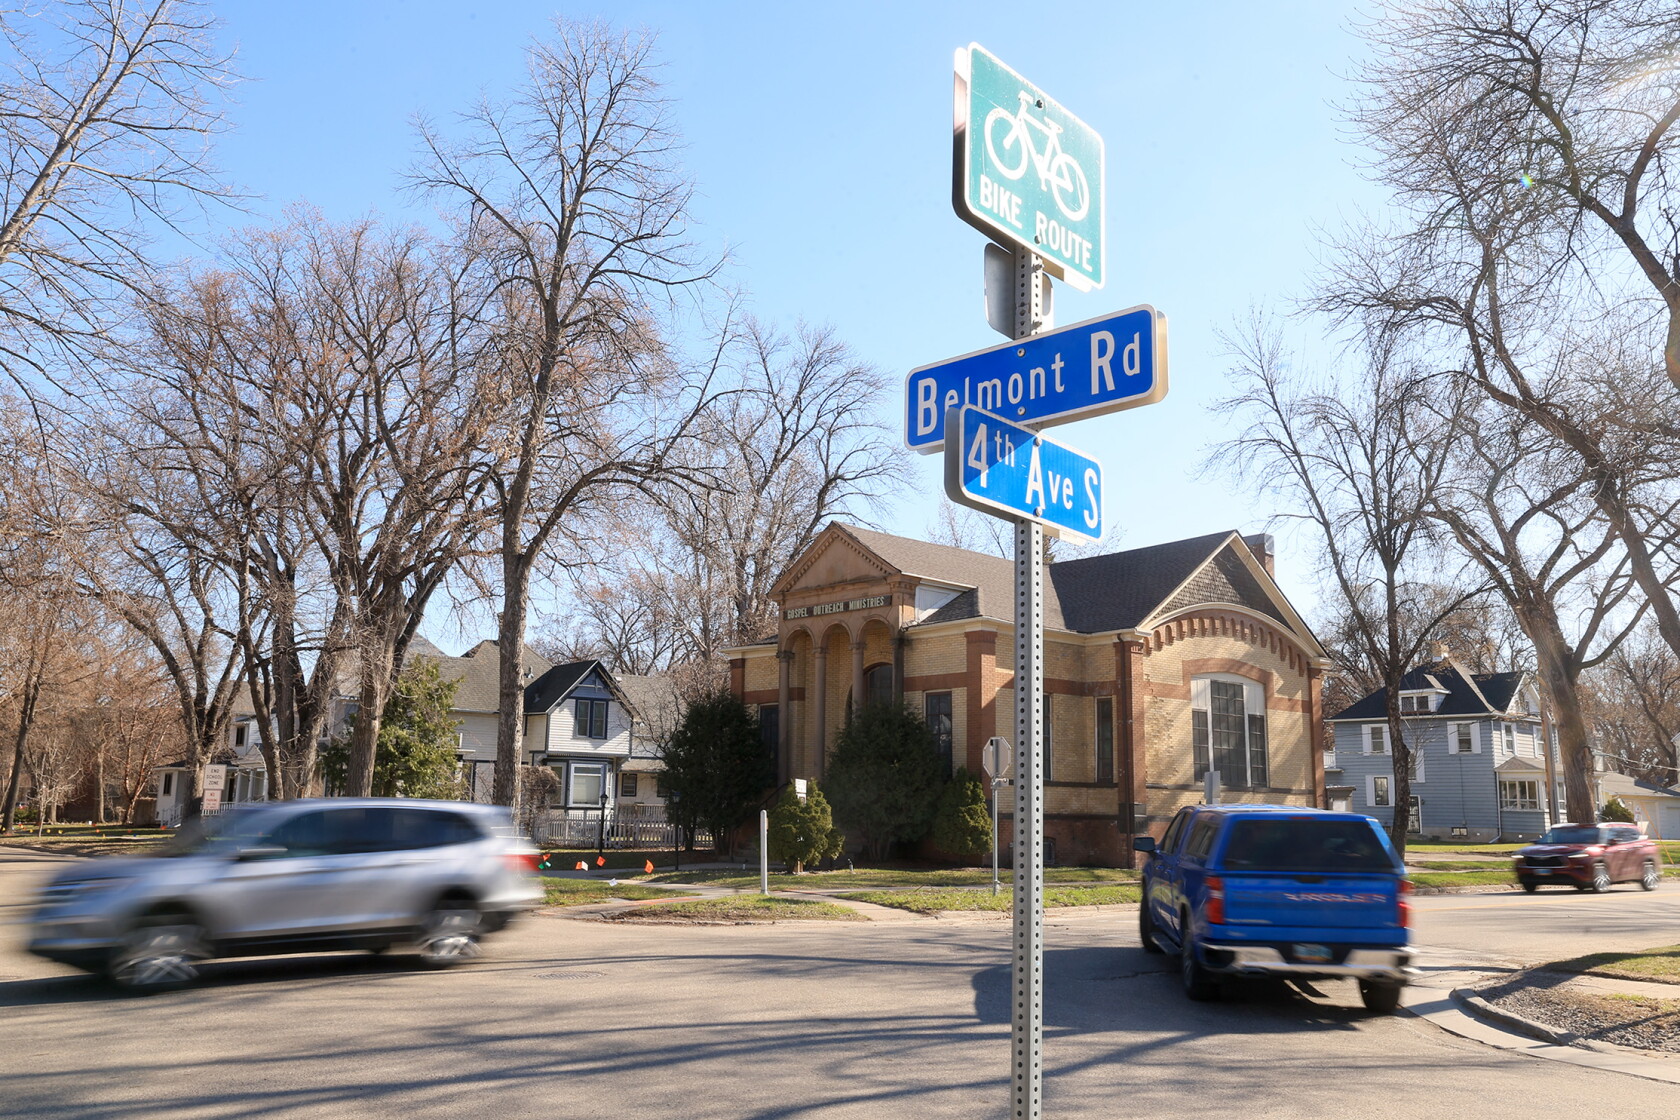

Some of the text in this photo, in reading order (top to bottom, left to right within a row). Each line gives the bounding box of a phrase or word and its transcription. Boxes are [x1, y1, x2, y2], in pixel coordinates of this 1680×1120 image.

[980, 174, 1093, 272] BIKE ROUTE
[917, 330, 1141, 436] Belmont Rd
[967, 422, 1099, 529] 4th Ave S
[787, 596, 885, 619] GOSPEL OUTREACH MINISTRIES
